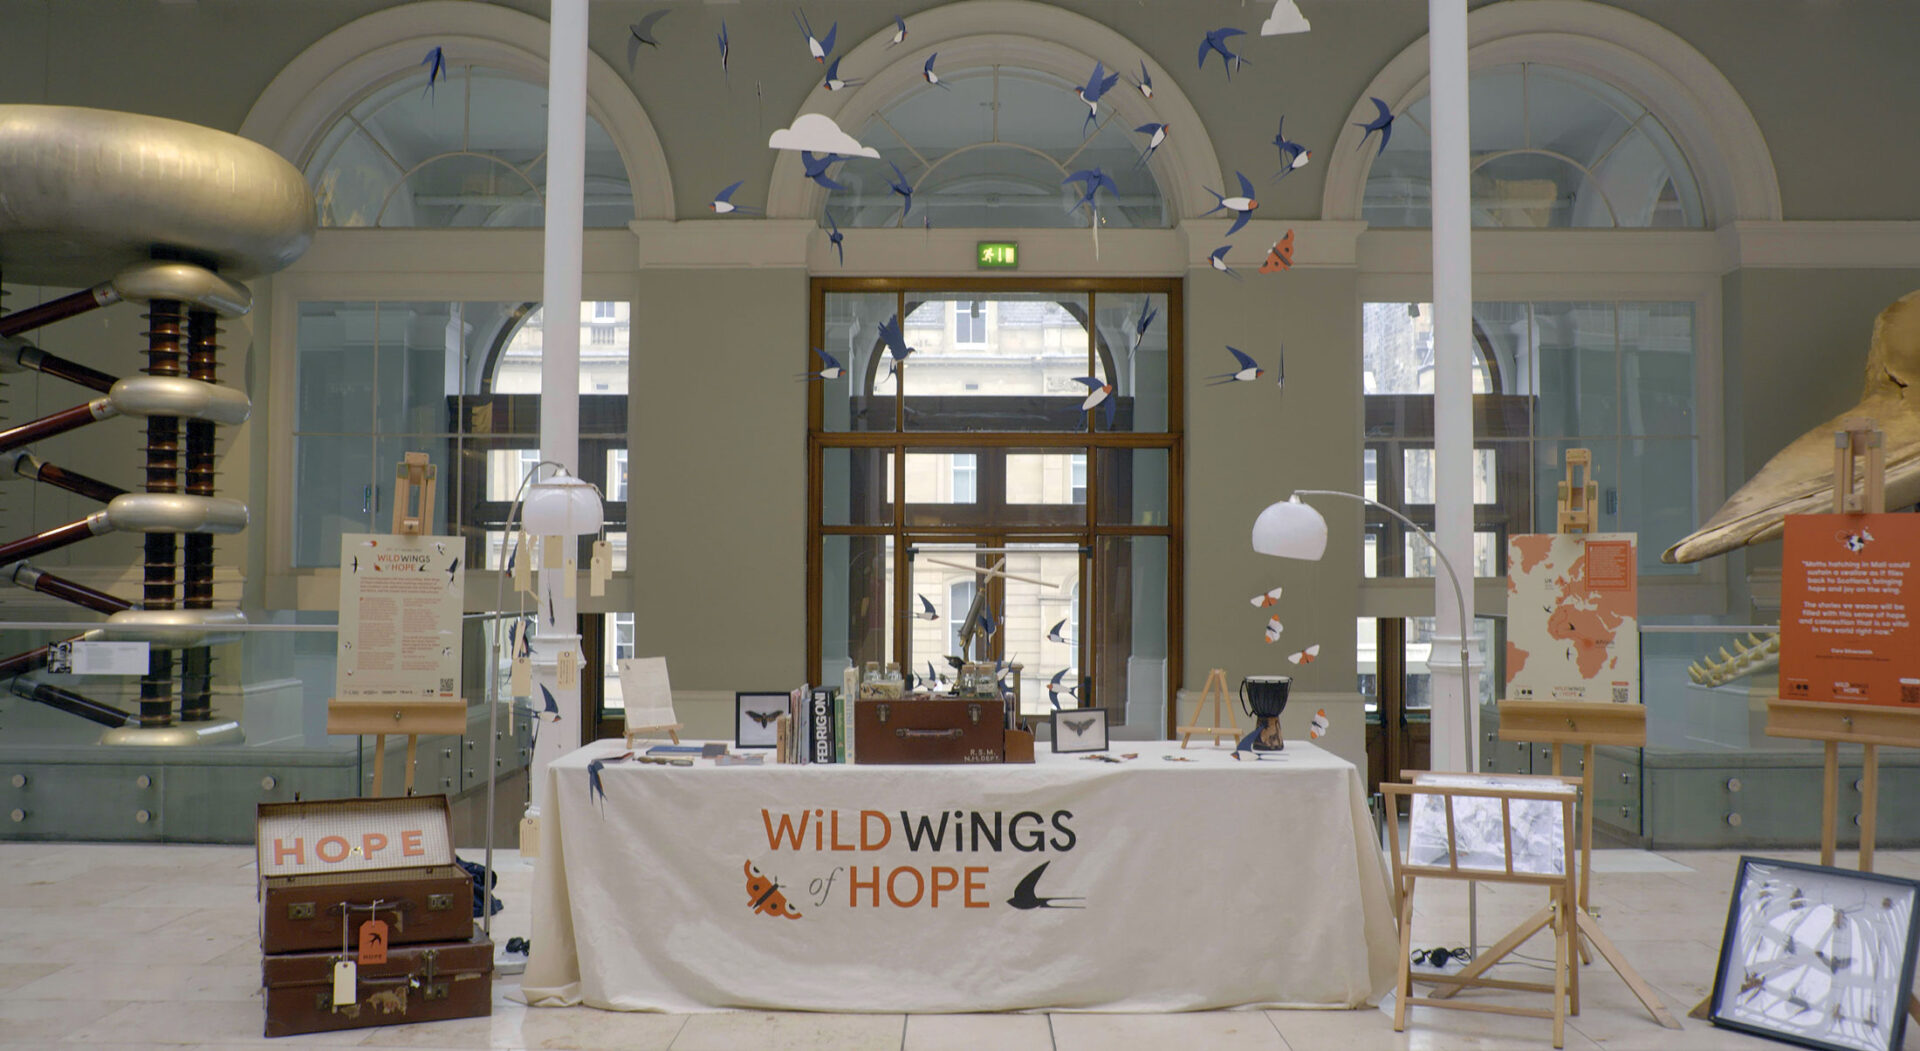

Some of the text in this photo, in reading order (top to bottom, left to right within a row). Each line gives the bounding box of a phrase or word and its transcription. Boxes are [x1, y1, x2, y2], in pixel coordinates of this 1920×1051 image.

[814, 692, 828, 763] FEDRIGONI
[274, 830, 424, 865] HOPE
[809, 865, 990, 908] of HOPE
